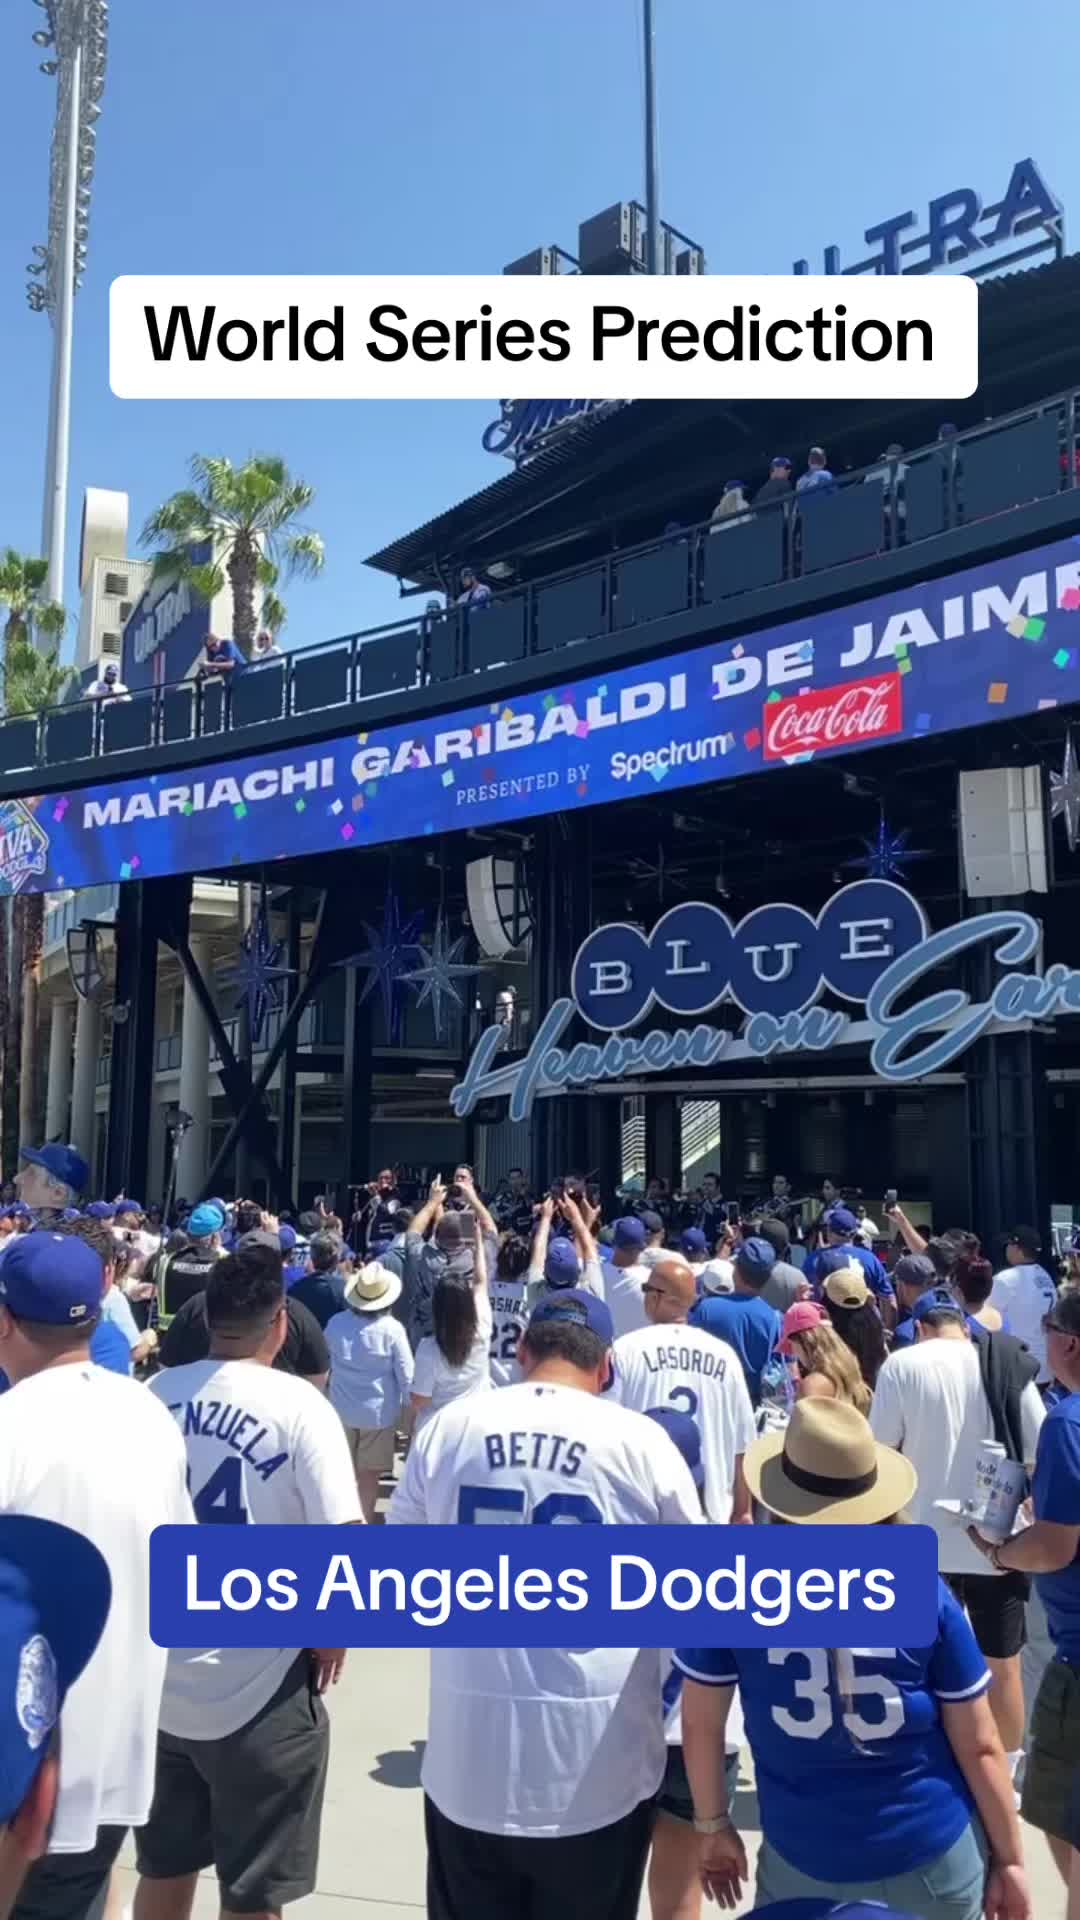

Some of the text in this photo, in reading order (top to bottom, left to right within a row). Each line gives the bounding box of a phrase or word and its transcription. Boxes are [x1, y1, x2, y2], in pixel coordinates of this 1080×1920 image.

[83, 757, 334, 829] MARIACHI
[351, 673, 687, 776] GARIBALDI
[712, 640, 814, 700] DE
[610, 734, 728, 782] Spectrum
[456, 764, 590, 805] PRESENTED BY
[589, 918, 894, 996] BLUE
[450, 998, 728, 1122] Heaven
[745, 1006, 850, 1055] on
[642, 1346, 727, 1383] LASORDA
[168, 1400, 289, 1481] NZUELA
[485, 1431, 587, 1478] BETTS
[186, 1456, 248, 1524] 4
[767, 1648, 905, 1741] 35
